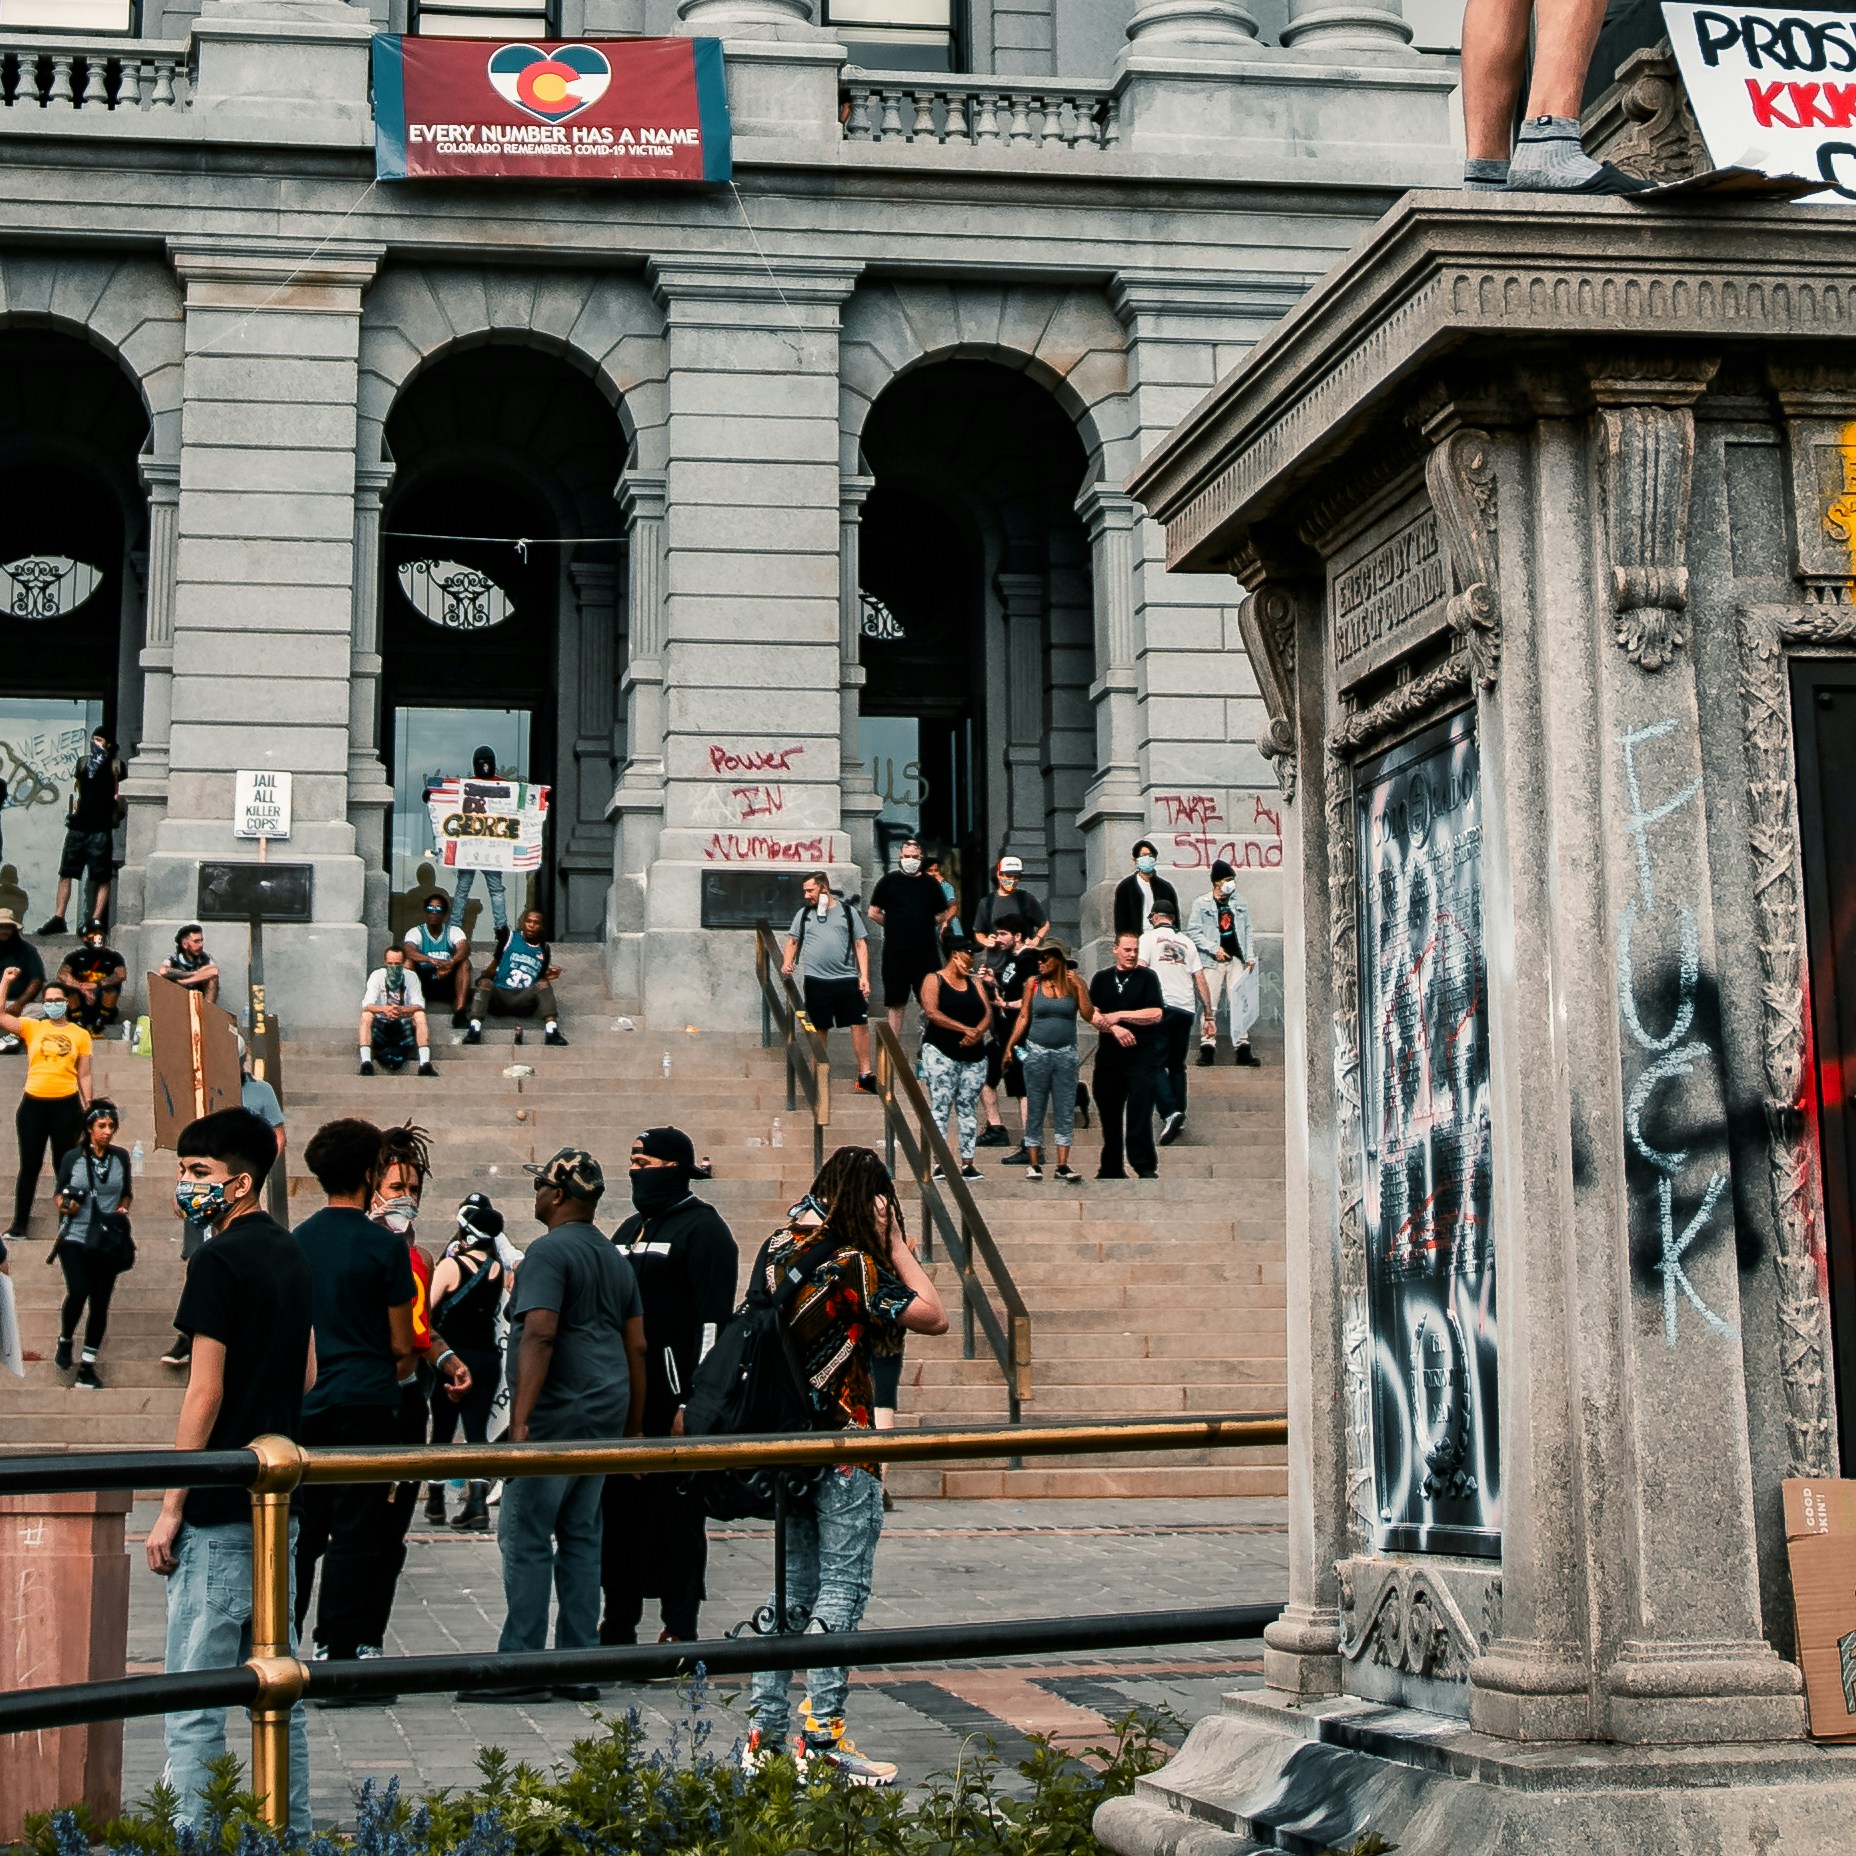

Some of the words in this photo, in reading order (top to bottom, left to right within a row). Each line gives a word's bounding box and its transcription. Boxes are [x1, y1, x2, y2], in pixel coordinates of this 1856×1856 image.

[409, 123, 477, 143] EVERY
[481, 124, 568, 144] NUMBER
[572, 126, 614, 144] HAS
[618, 127, 636, 144] A
[640, 127, 700, 145] NAME
[436, 142, 501, 154] COLORADO
[503, 143, 572, 155] REMEMBERS
[575, 143, 626, 156] COVID-19
[628, 144, 674, 157] VICTIMS
[16, 733, 45, 759] WE
[49, 727, 88, 757] NEED
[707, 744, 806, 774] Power
[252, 773, 277, 788] JAIL
[254, 789, 275, 803] ALL
[732, 784, 783, 821] IN
[245, 805, 281, 817] KILLER
[246, 817, 278, 830] COPS!
[1154, 794, 1224, 834] TAKE
[442, 813, 521, 840] GEORGE
[1172, 811, 1283, 869] Stand
[506, 968, 532, 989] 33
[1614, 718, 1740, 1346] FUCK
[1802, 1486, 1815, 1528] GOOD
